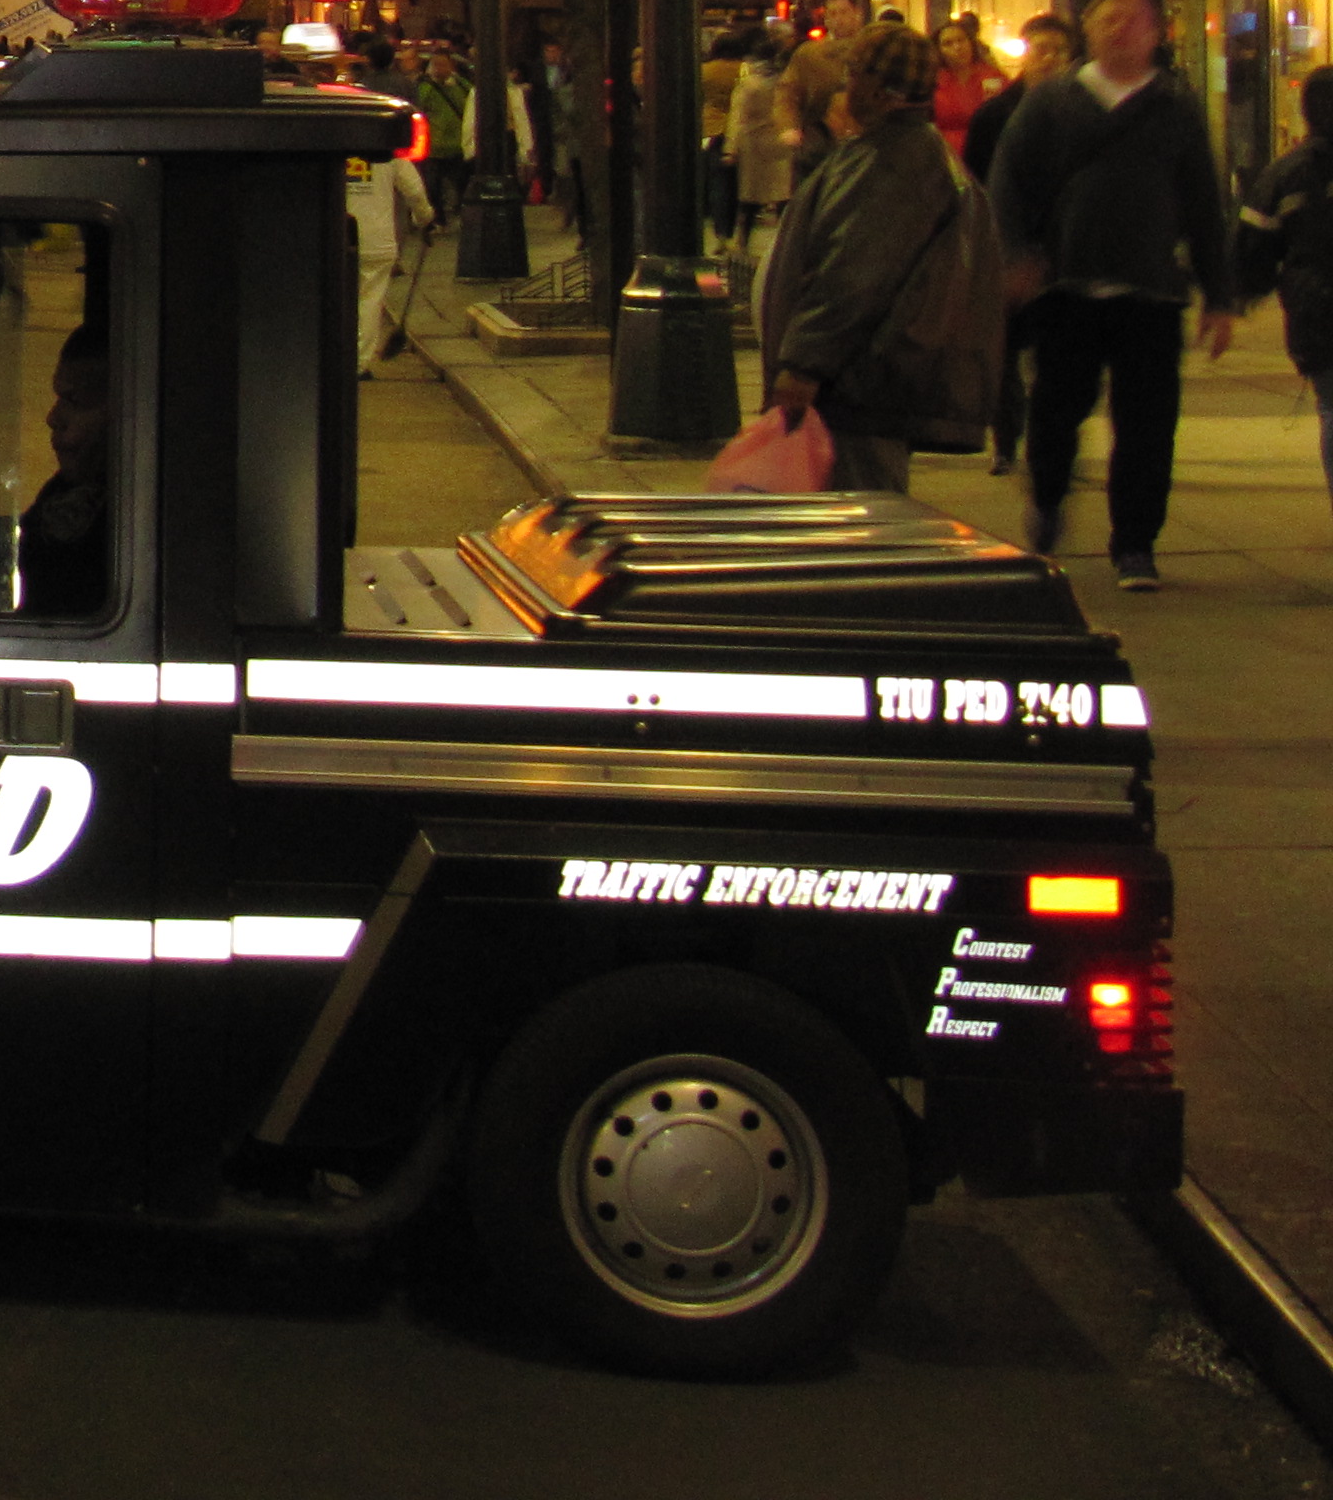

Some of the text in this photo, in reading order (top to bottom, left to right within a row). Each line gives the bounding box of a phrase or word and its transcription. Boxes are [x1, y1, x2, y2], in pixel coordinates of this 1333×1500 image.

[876, 676, 934, 720] TIU
[943, 678, 1009, 722] PED
[558, 859, 954, 912] TRAFFIC ENFORCEMENT
